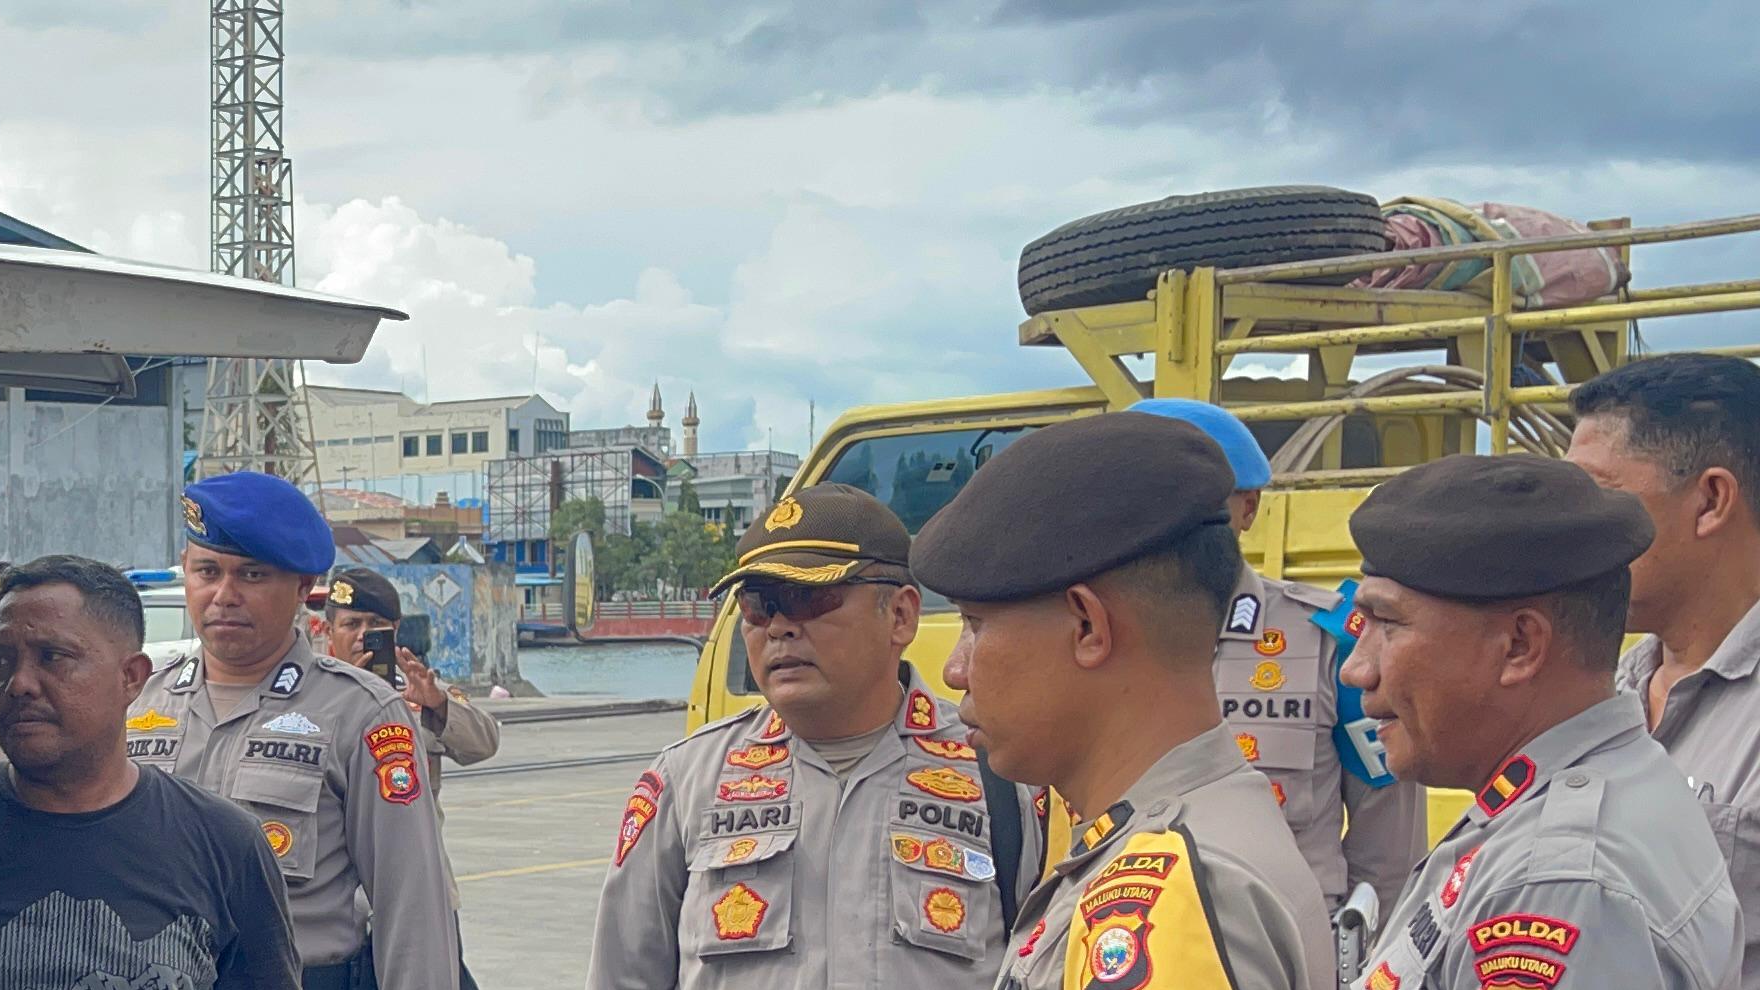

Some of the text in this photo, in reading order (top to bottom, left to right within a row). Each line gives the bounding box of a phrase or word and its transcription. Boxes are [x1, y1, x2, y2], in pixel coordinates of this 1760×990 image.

[1223, 698, 1311, 718] POLRI
[371, 727, 409, 743] POLDA
[245, 740, 323, 766] POLRI
[711, 805, 791, 834] HARI
[899, 800, 983, 837] POLRI
[1100, 856, 1165, 879] OLDA
[1085, 886, 1154, 913] MALUKU UTARA
[1476, 920, 1566, 945] POLDA
[1481, 956, 1555, 978] MALUKU UTARA
